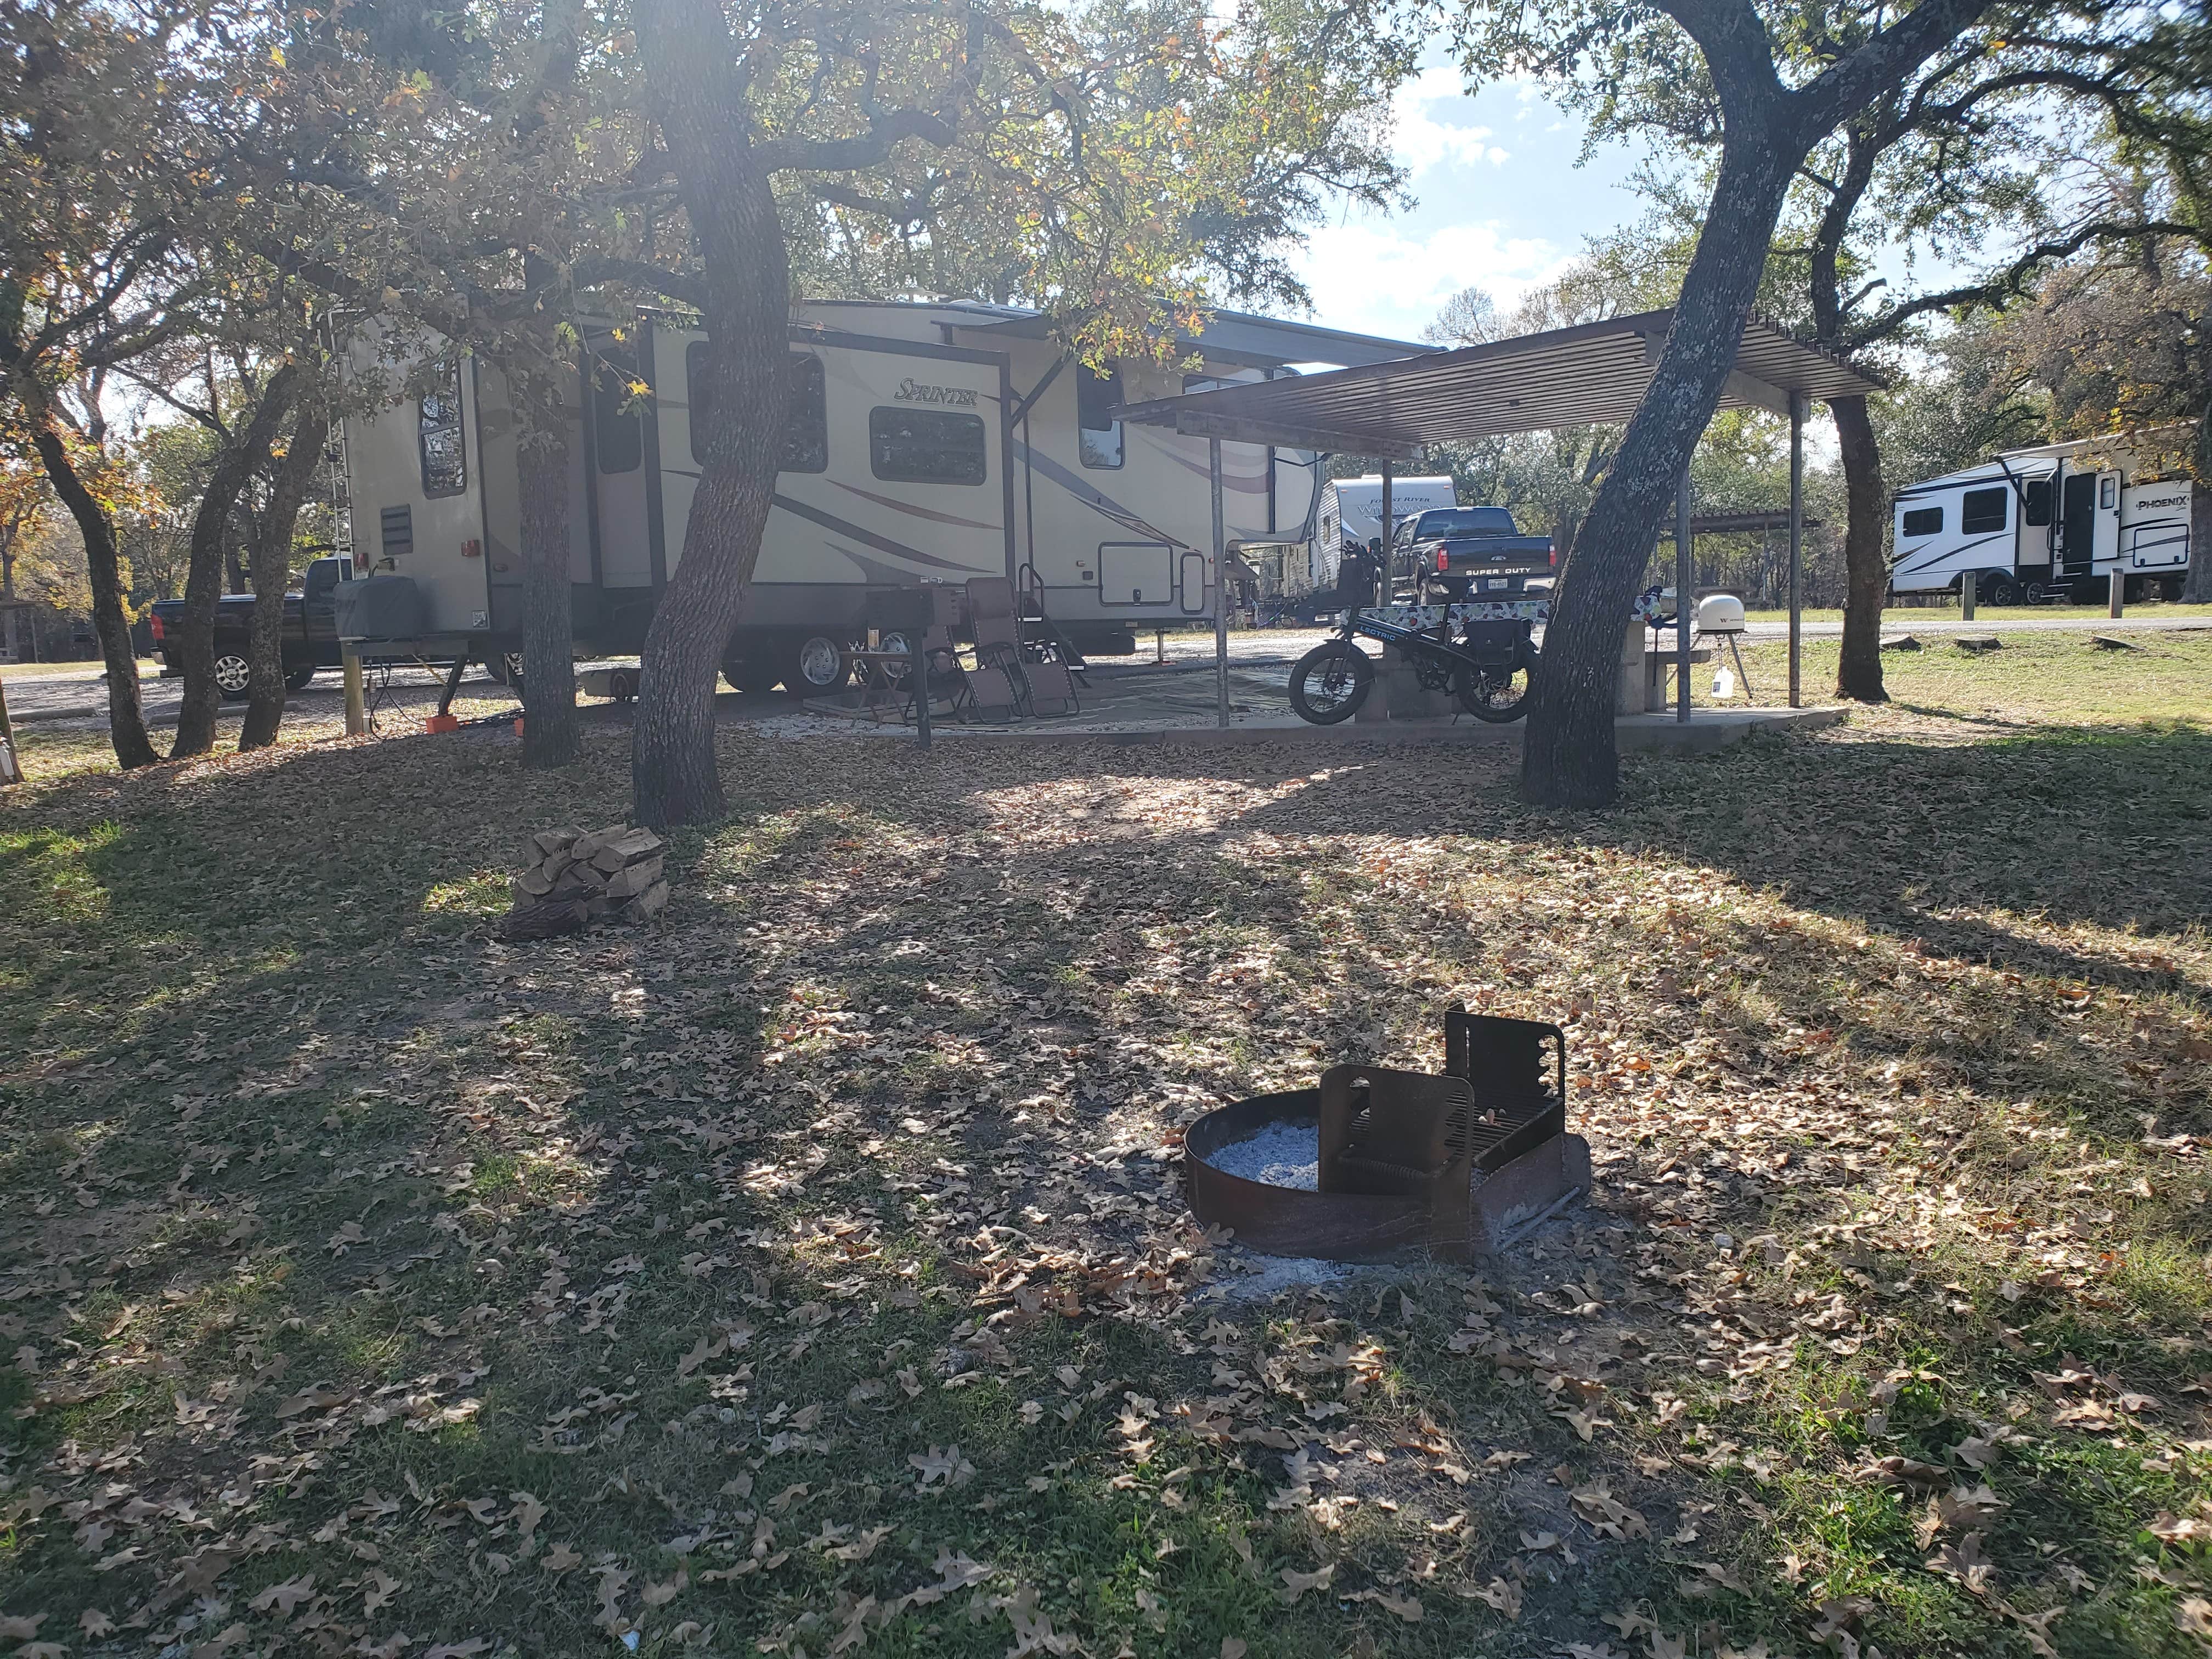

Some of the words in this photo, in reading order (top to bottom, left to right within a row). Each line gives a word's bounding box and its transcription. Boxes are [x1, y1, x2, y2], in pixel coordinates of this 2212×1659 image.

[894, 377, 978, 407] SPRINTER
[2137, 496, 2187, 510] PHOENIX
[1360, 625, 1396, 641] LECTRIC
